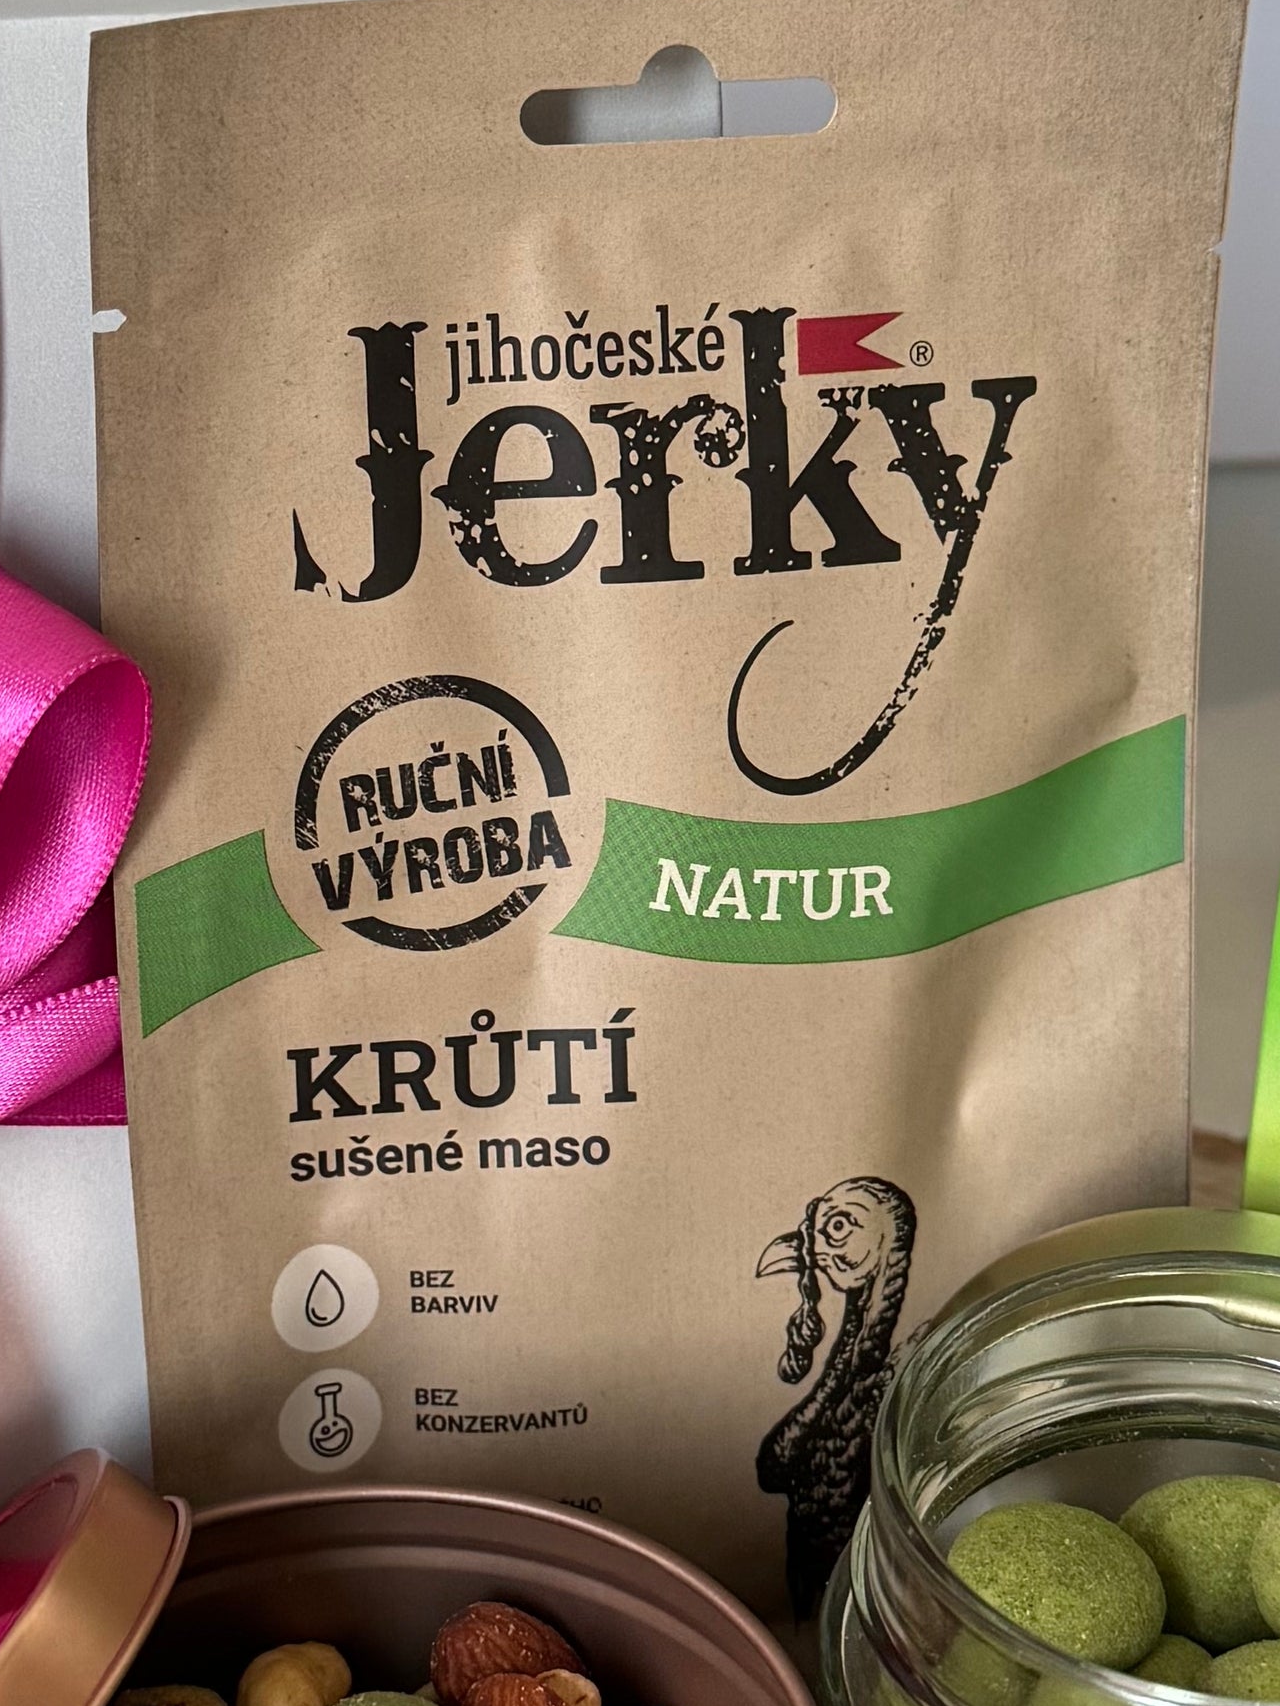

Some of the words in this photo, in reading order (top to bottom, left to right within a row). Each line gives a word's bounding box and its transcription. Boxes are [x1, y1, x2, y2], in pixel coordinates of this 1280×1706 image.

[445, 303, 726, 404] jihočeské
[293, 306, 1037, 795] Jerky
[339, 729, 516, 833] RUČNÍ
[311, 808, 572, 914] VÝROBA
[648, 857, 894, 923] NATUR
[286, 1007, 638, 1123] KRŮTÍ
[289, 1129, 463, 1183] sušené
[478, 1133, 611, 1172] maso
[409, 1270, 455, 1289] BEZ
[410, 1294, 499, 1315] BARVIV
[414, 1387, 459, 1407] BEZ
[415, 1401, 589, 1434] KONZERVANTŮ
